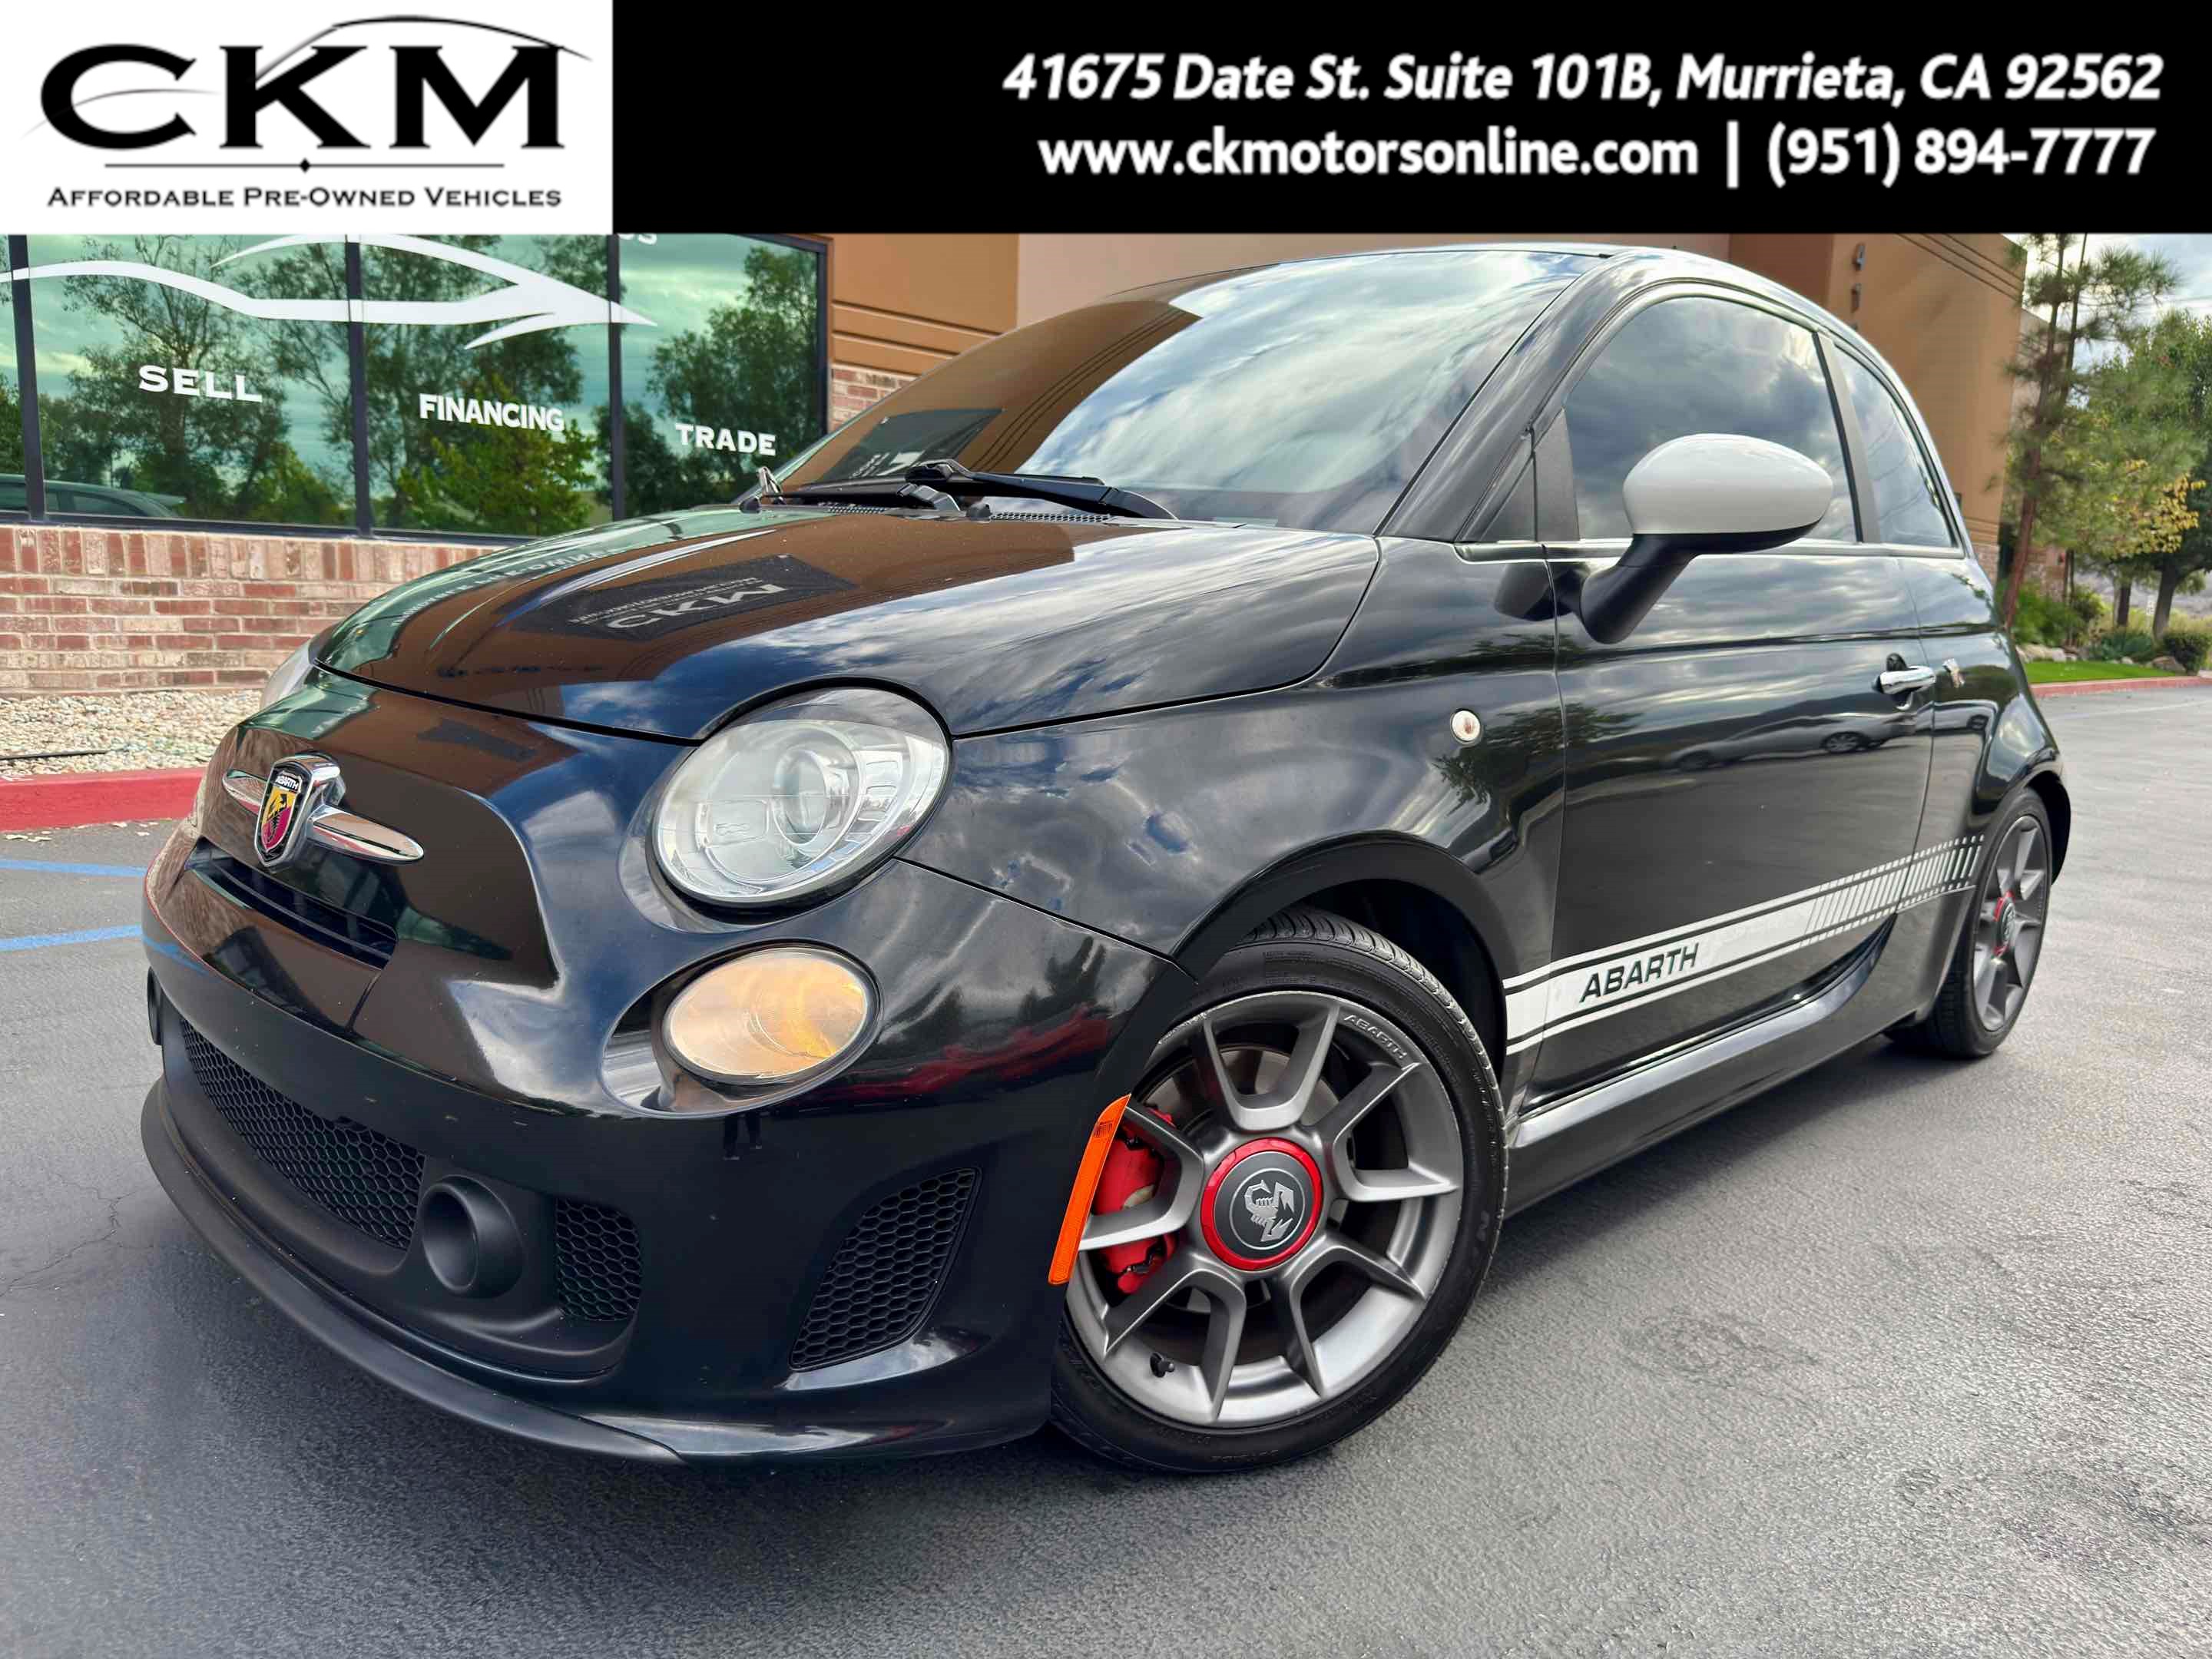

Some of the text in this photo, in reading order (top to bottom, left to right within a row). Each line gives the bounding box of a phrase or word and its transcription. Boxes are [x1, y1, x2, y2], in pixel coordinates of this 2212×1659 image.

[138, 364, 263, 403] SELL
[419, 392, 566, 432] FINANCING
[674, 422, 777, 457] TRADE
[1579, 942, 1700, 1004] ABARTH
[1343, 1014, 1408, 1060] ABARTH
